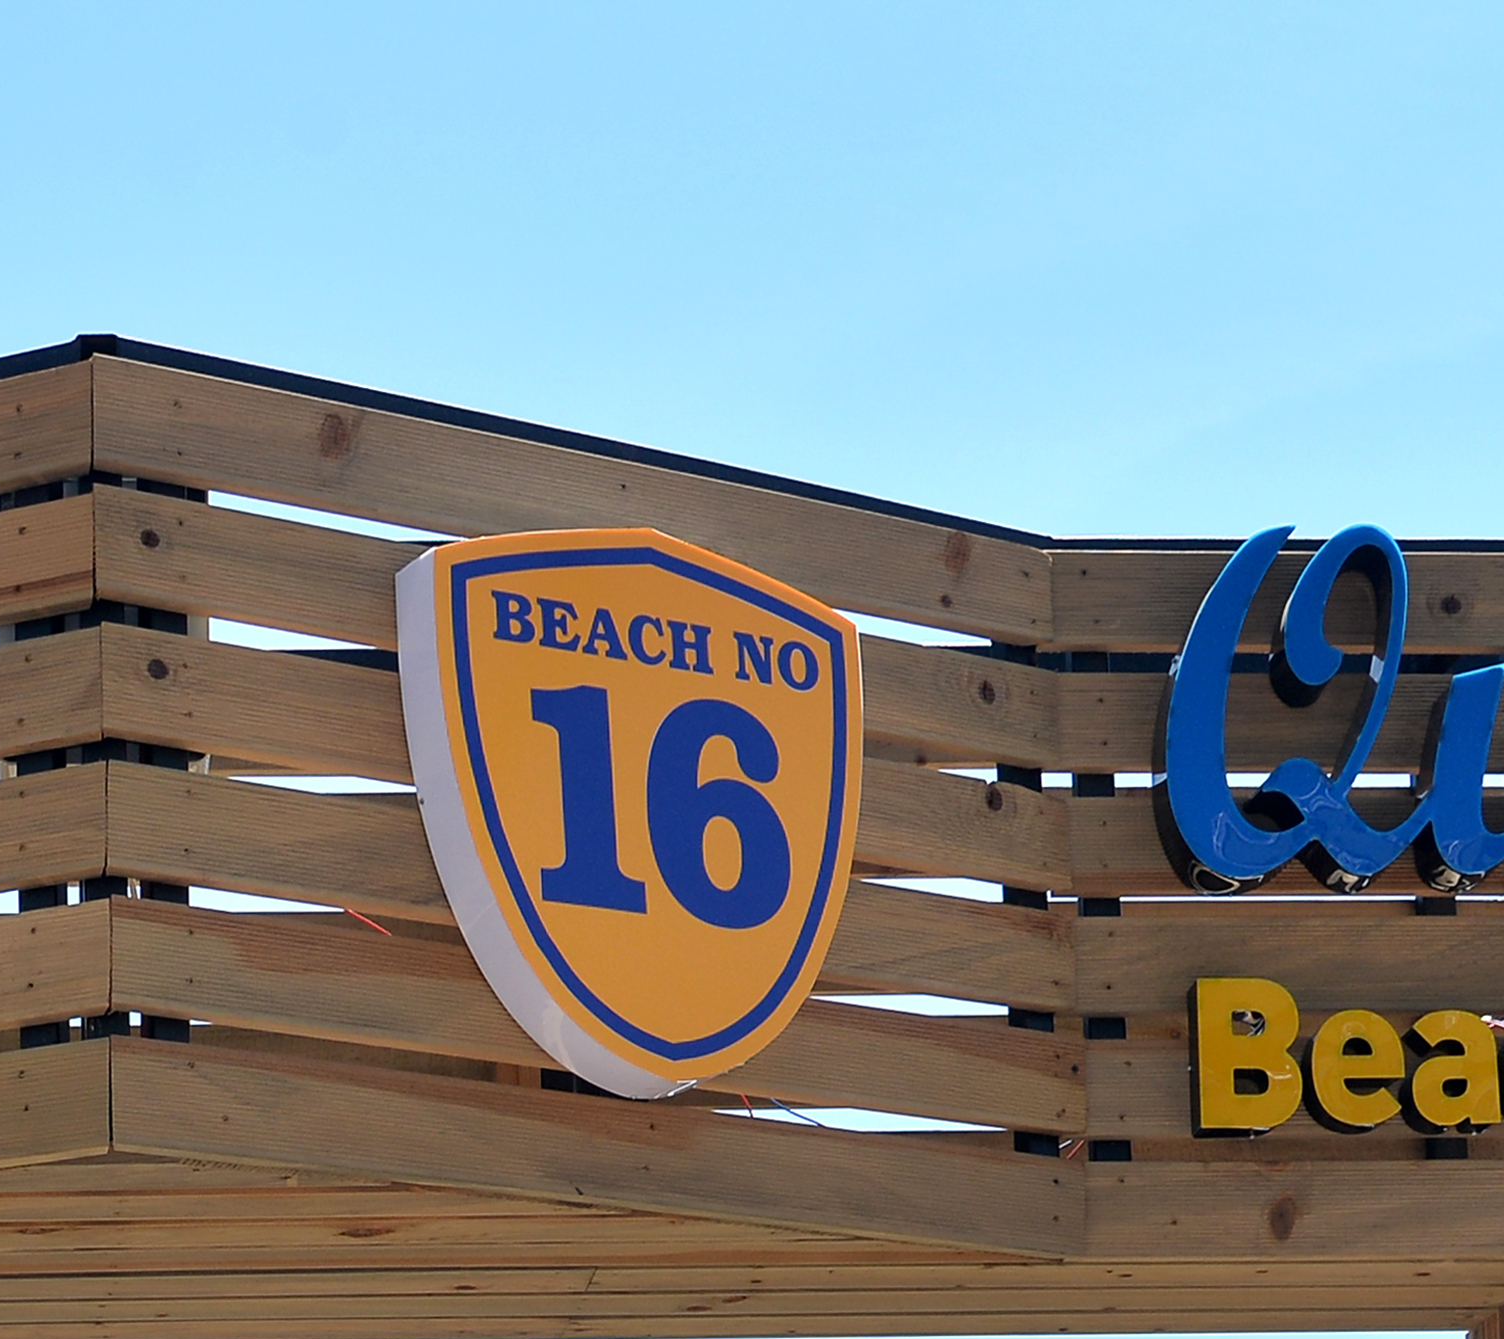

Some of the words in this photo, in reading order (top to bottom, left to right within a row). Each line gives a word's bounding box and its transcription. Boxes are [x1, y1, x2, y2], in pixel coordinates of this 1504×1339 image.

[490, 589, 715, 675] BEACH
[732, 630, 821, 692] NO
[530, 684, 792, 930] 16
